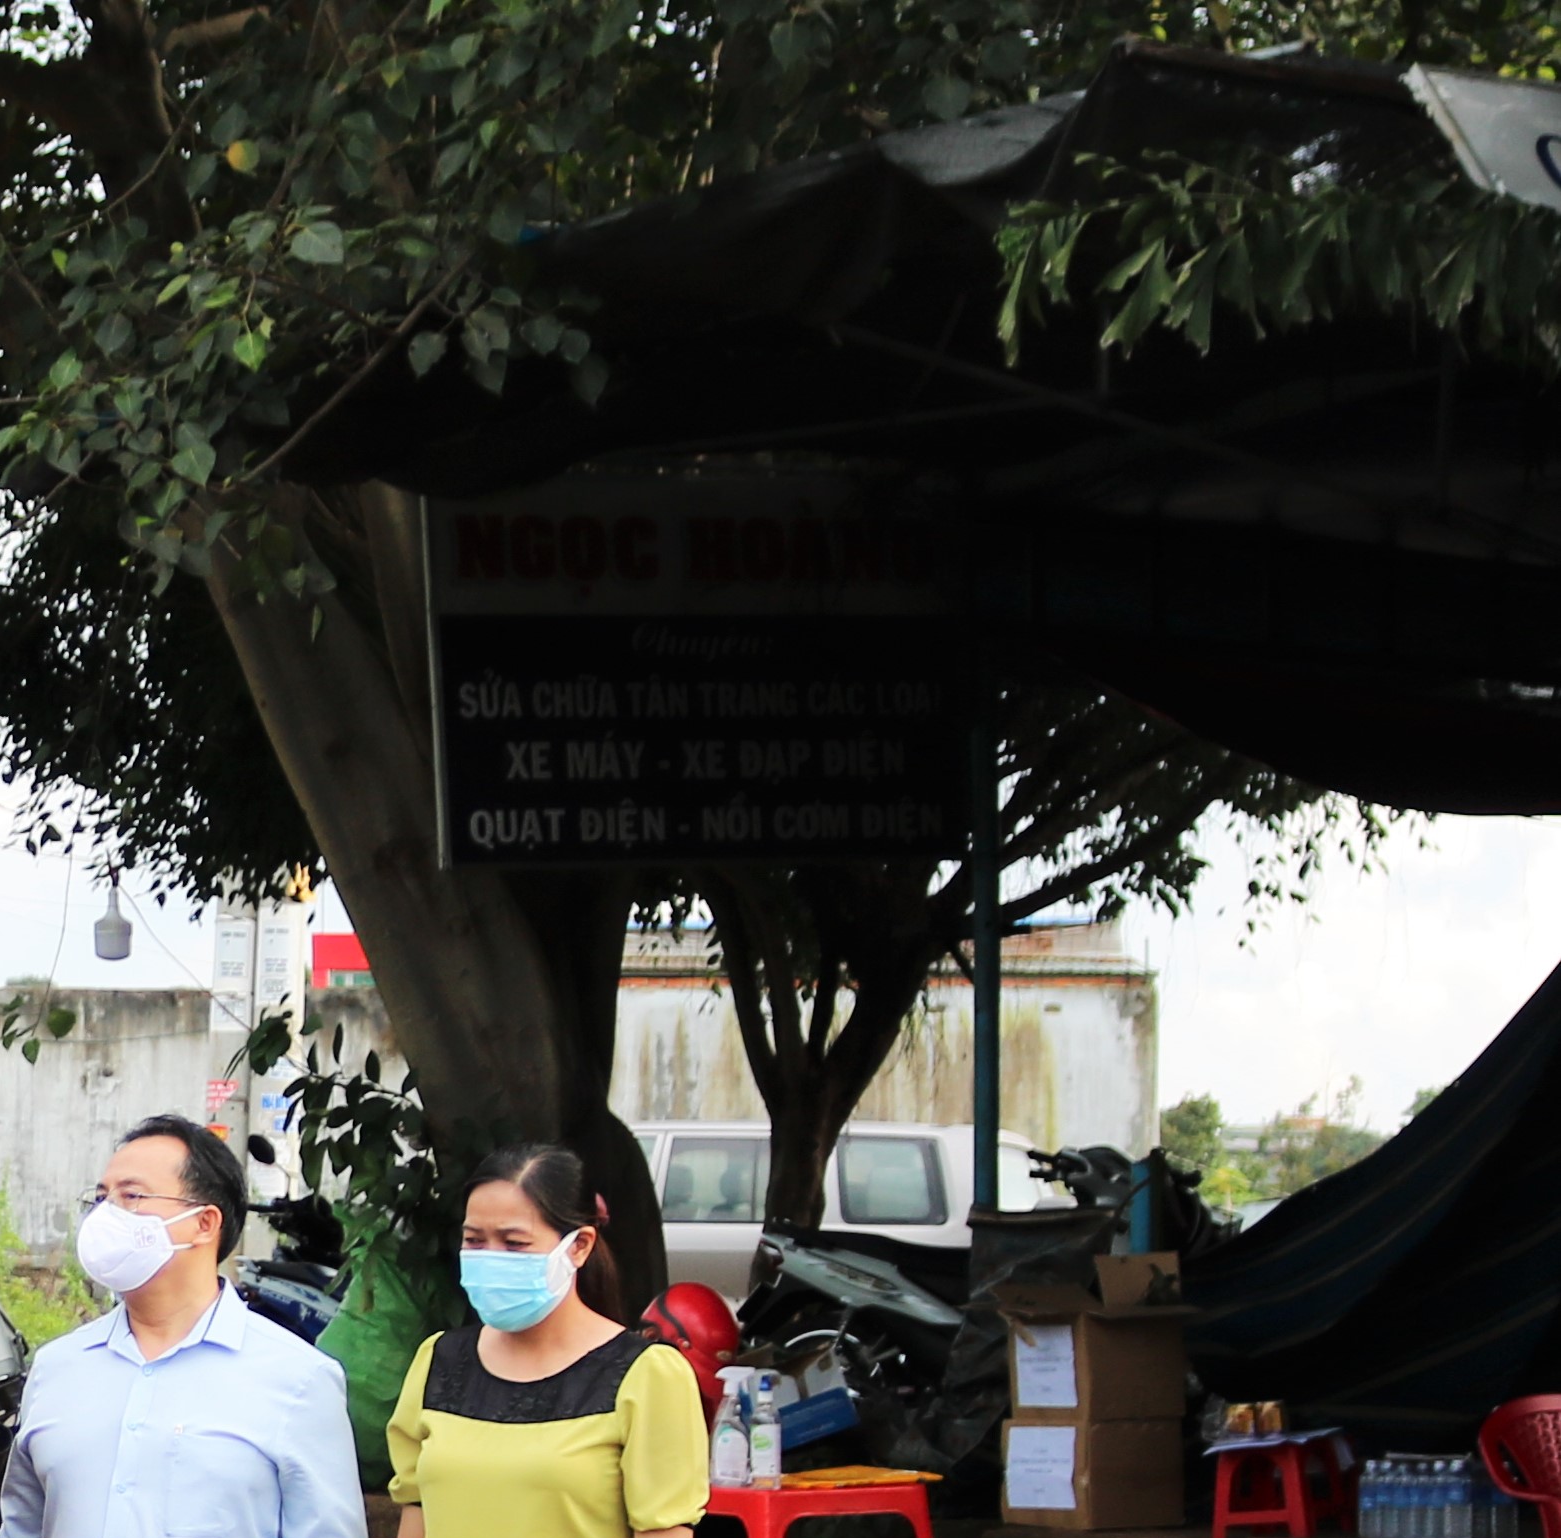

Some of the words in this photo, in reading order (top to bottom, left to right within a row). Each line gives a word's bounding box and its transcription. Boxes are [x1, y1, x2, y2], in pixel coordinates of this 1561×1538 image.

[454, 513, 660, 597] NGỌC
[458, 667, 523, 721] SỬA
[531, 673, 618, 717] CHỮA
[625, 673, 689, 717] TÂN
[697, 680, 798, 716] TRANG
[807, 672, 867, 716] CÁC
[505, 740, 553, 780] XE
[565, 730, 646, 780] MÁY
[681, 740, 725, 780] XE
[738, 739, 811, 788] ĐẠP
[822, 729, 906, 783] ĐIỆN
[468, 808, 564, 857] QUẠT
[579, 798, 667, 847] ĐIỆN
[773, 802, 849, 840] CƠM
[860, 797, 944, 842] ĐIỆN
